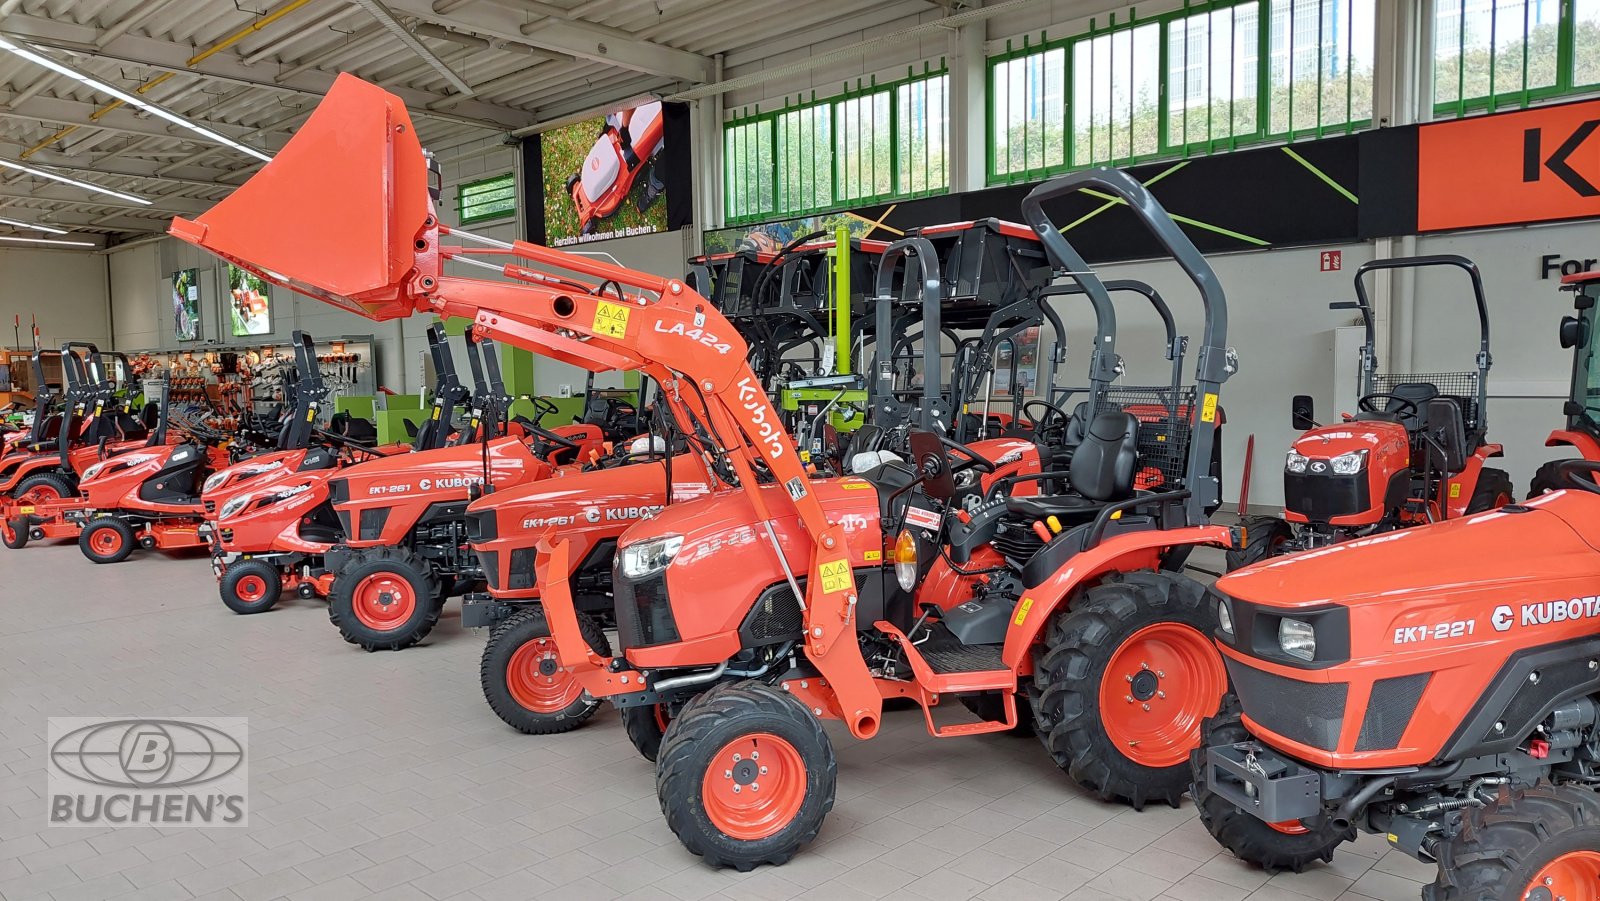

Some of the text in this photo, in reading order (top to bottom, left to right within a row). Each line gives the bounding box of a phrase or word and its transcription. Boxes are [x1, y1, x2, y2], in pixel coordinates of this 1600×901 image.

[554, 235, 578, 247] Herzlich
[578, 230, 614, 243] willkommen
[615, 227, 625, 238] bei
[1541, 253, 1597, 280] For
[654, 319, 732, 355] LA424
[737, 376, 784, 460] Kubota
[368, 484, 411, 495] EK1-261
[522, 515, 575, 529] EK1-261
[1393, 619, 1475, 645] EK1-221
